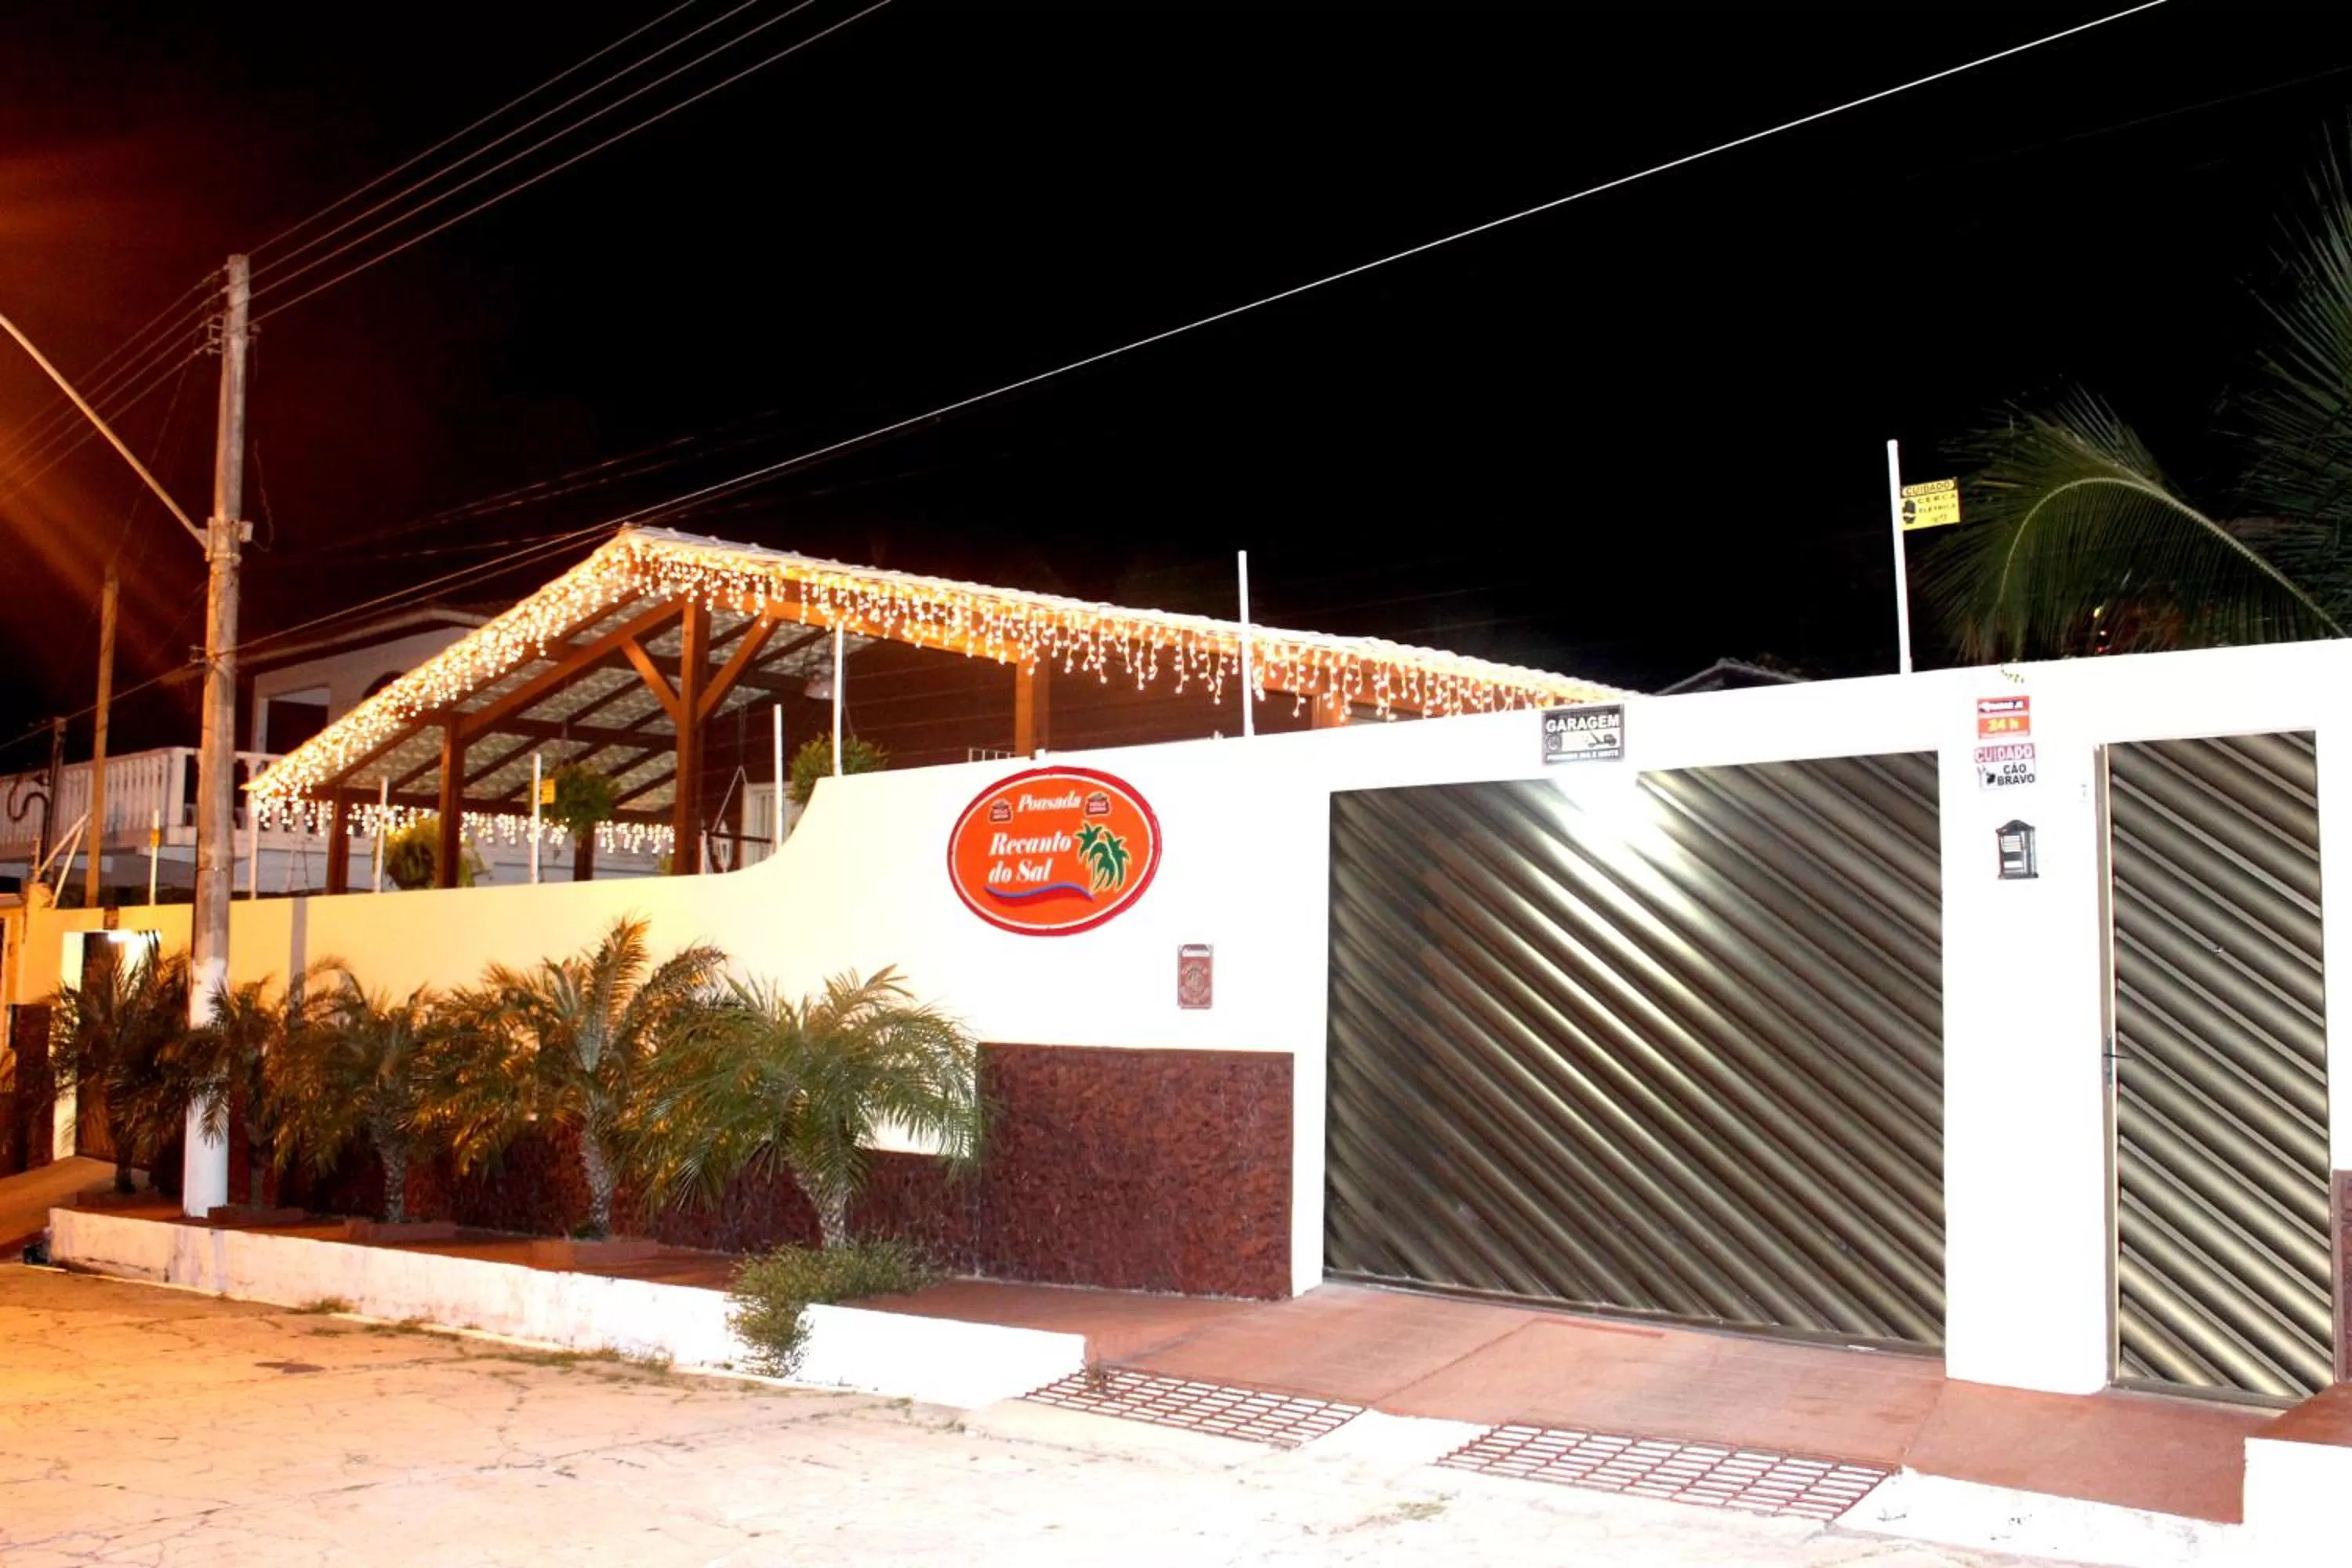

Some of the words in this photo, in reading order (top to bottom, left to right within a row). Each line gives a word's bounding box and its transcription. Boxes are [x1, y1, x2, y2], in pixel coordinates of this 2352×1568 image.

[1905, 481, 1951, 495] CUIDADO
[1545, 714, 1620, 733] GARAGEM
[1976, 745, 2033, 763] CUIDADO
[1997, 772, 2035, 786] BRAVO
[1018, 790, 1082, 813] Pousada
[988, 830, 1072, 856] Recanto
[988, 860, 1012, 884] do
[1016, 857, 1053, 882] Sal
